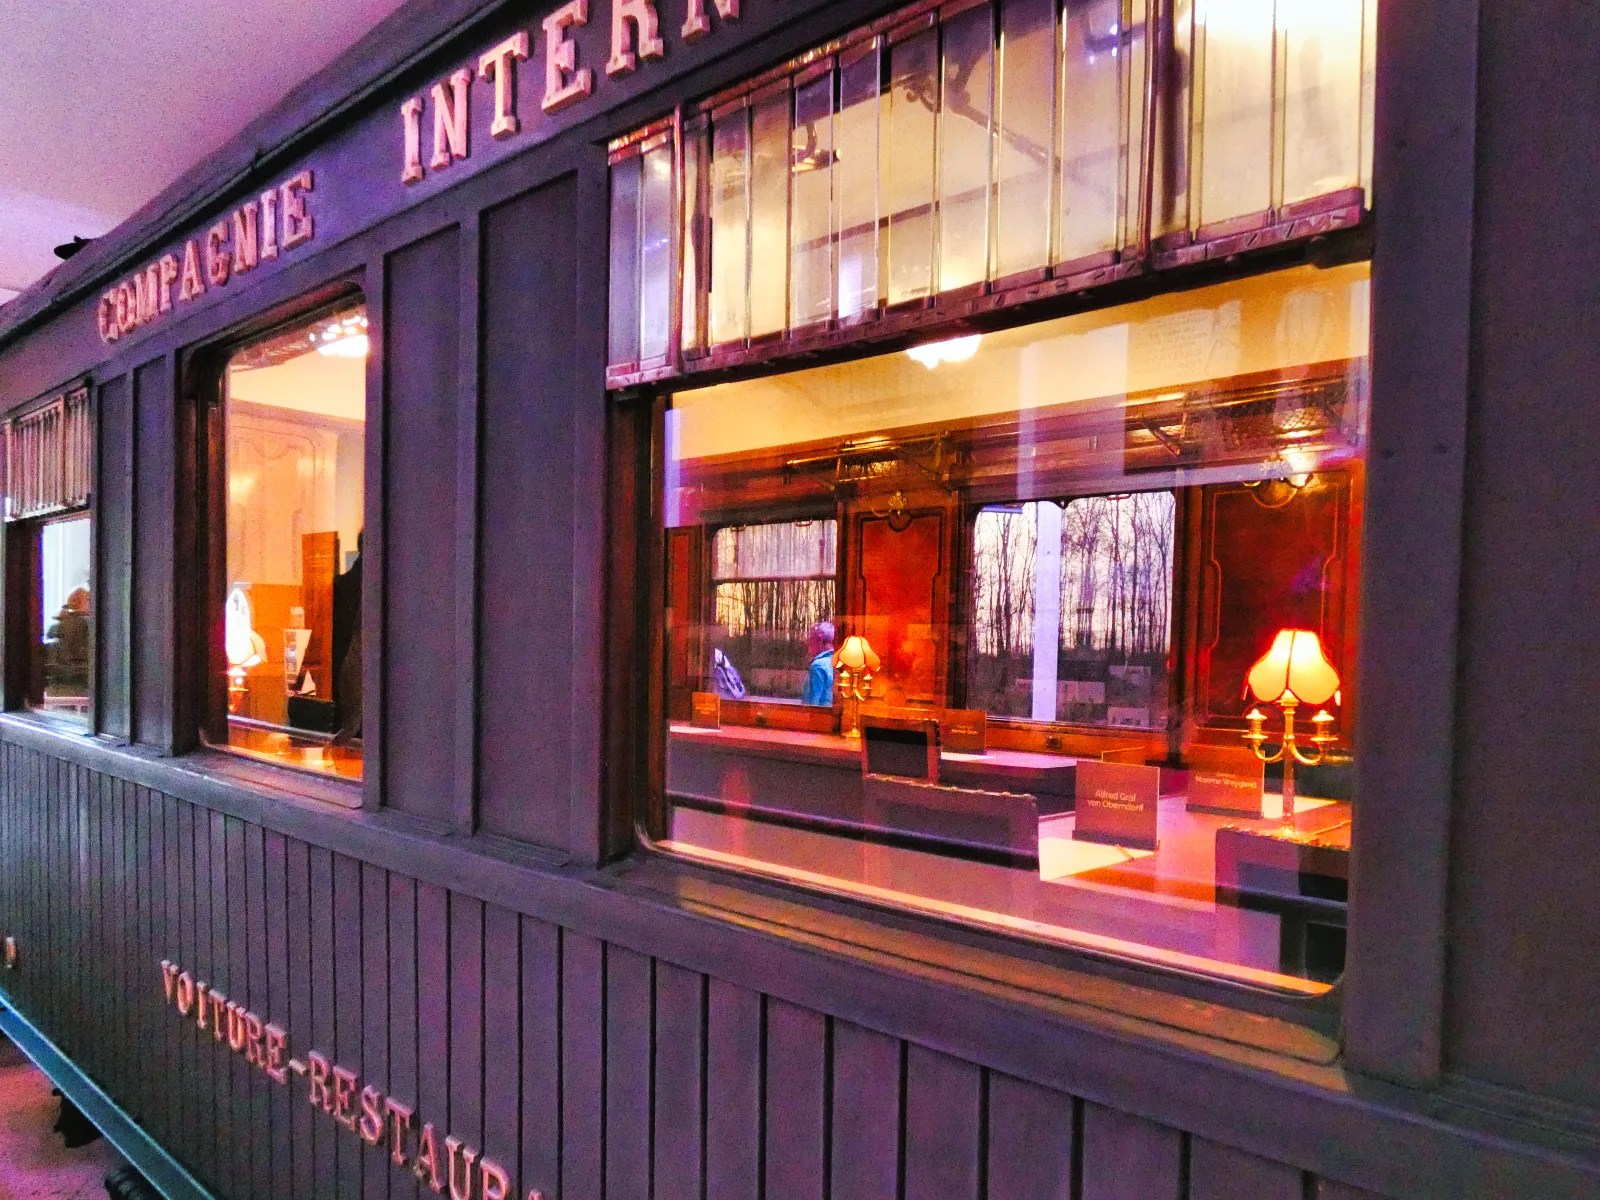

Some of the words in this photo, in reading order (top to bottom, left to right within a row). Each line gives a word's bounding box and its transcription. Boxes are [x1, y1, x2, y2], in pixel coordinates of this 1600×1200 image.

[98, 170, 314, 344] COMPAGNIE
[1095, 789, 1118, 800] Alfred
[1119, 792, 1136, 802] Graf
[161, 959, 543, 1200] VOITURE-RESTAUR
